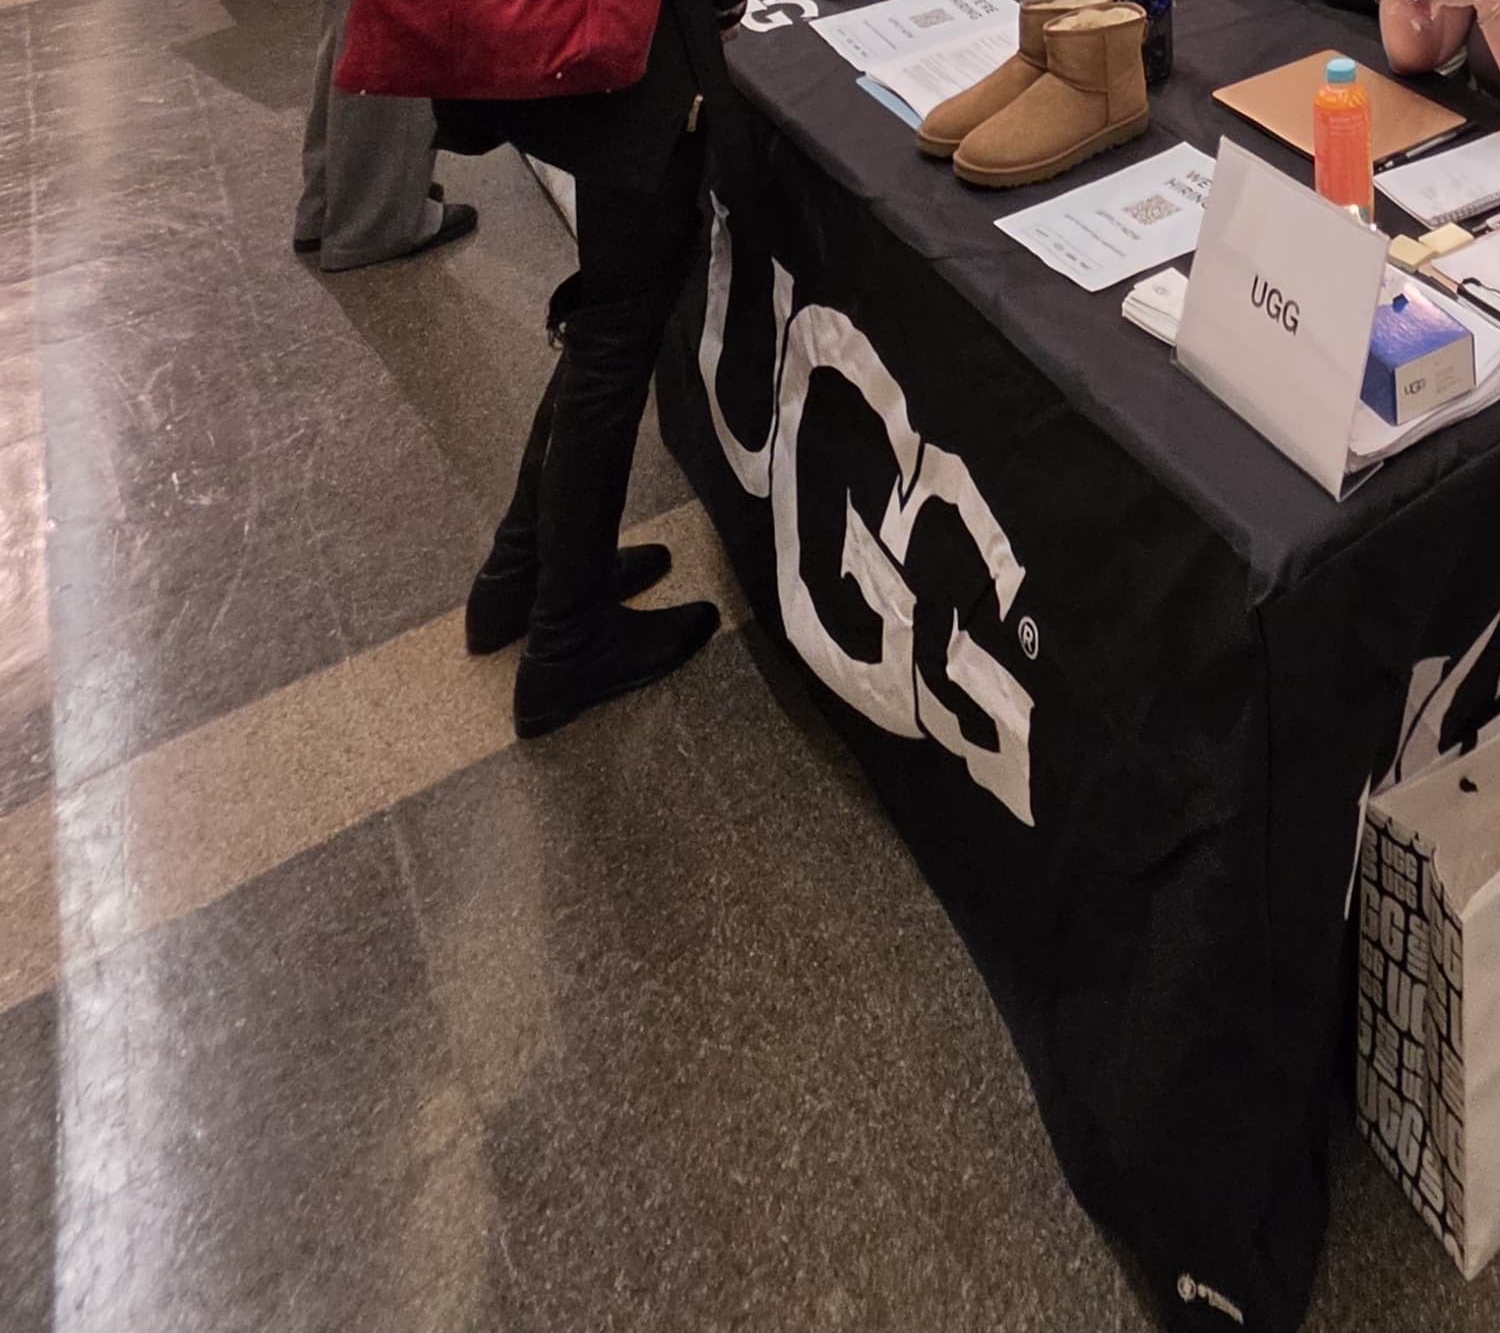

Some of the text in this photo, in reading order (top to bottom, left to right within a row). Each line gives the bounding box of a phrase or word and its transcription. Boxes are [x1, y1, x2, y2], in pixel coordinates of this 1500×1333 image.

[1251, 274, 1300, 336] UGG
[1404, 378, 1427, 397] UGG
[698, 190, 1035, 828] UGG
